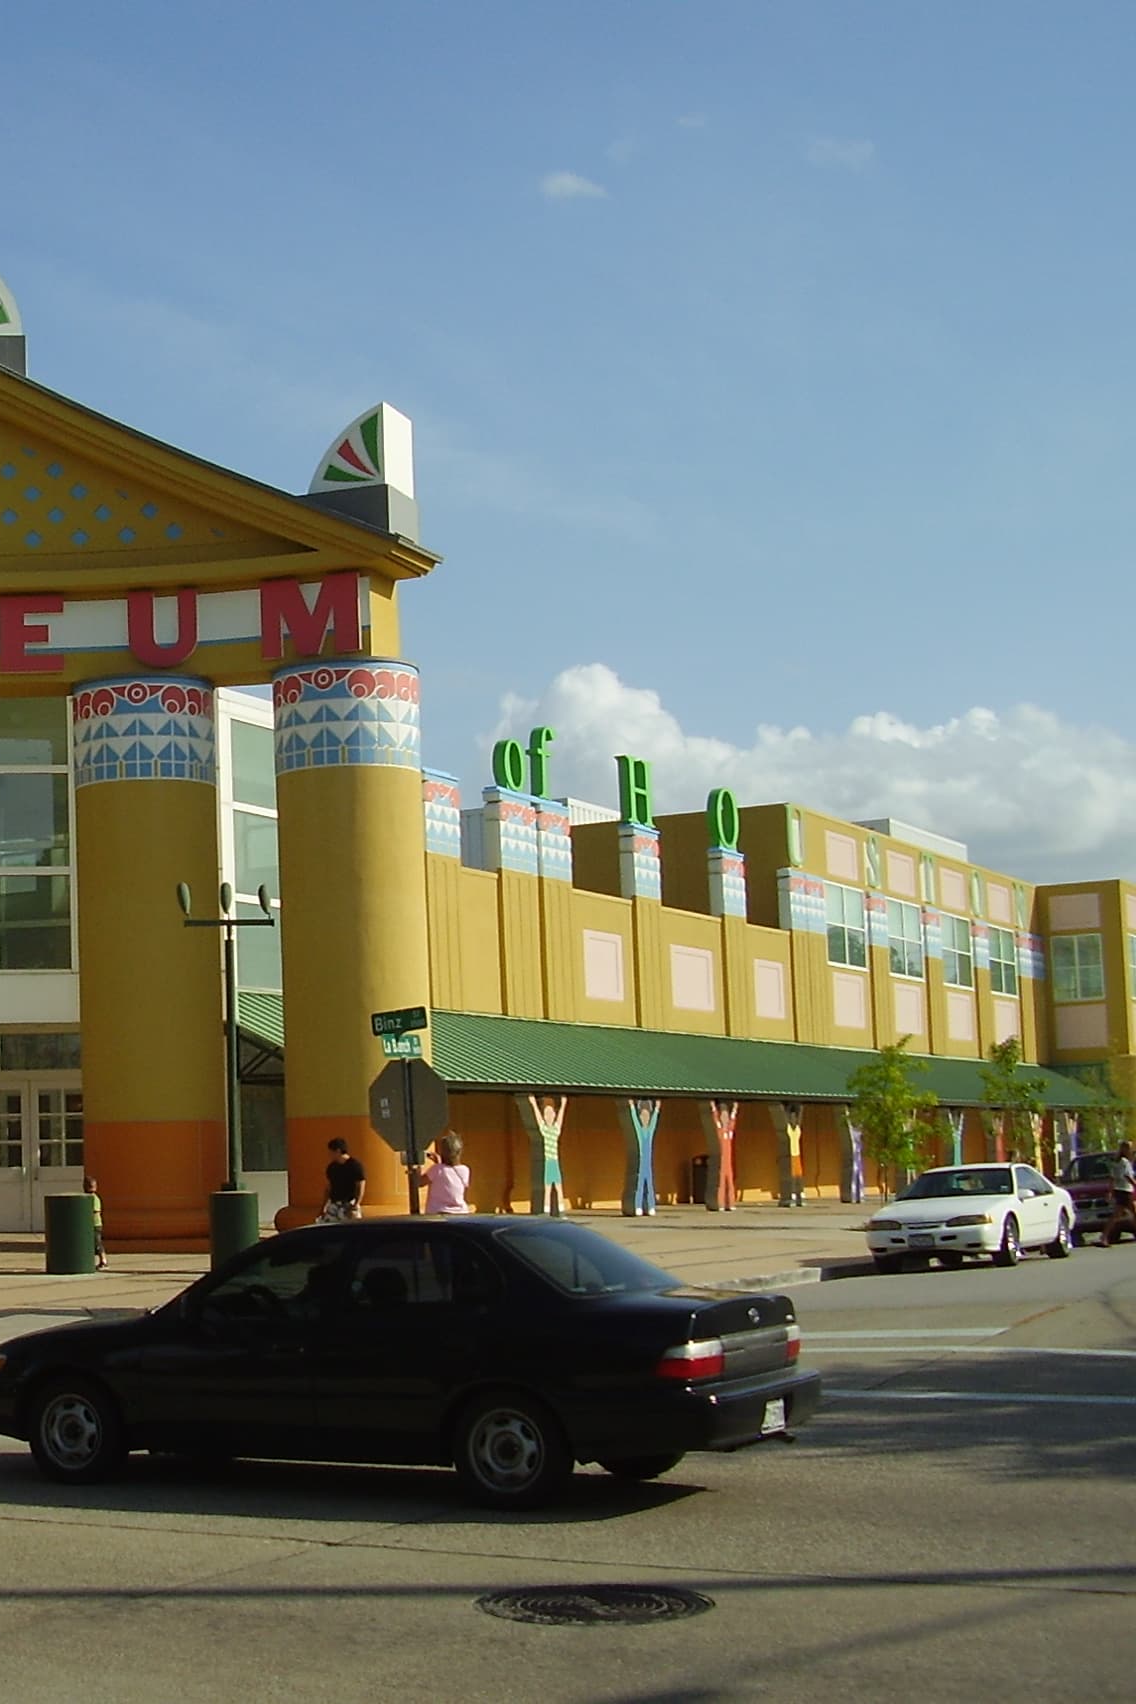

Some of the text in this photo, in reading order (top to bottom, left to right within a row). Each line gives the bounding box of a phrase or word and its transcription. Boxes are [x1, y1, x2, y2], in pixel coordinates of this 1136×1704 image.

[491, 726, 1034, 930] of HOUSTON
[374, 1015, 402, 1032] Binz
